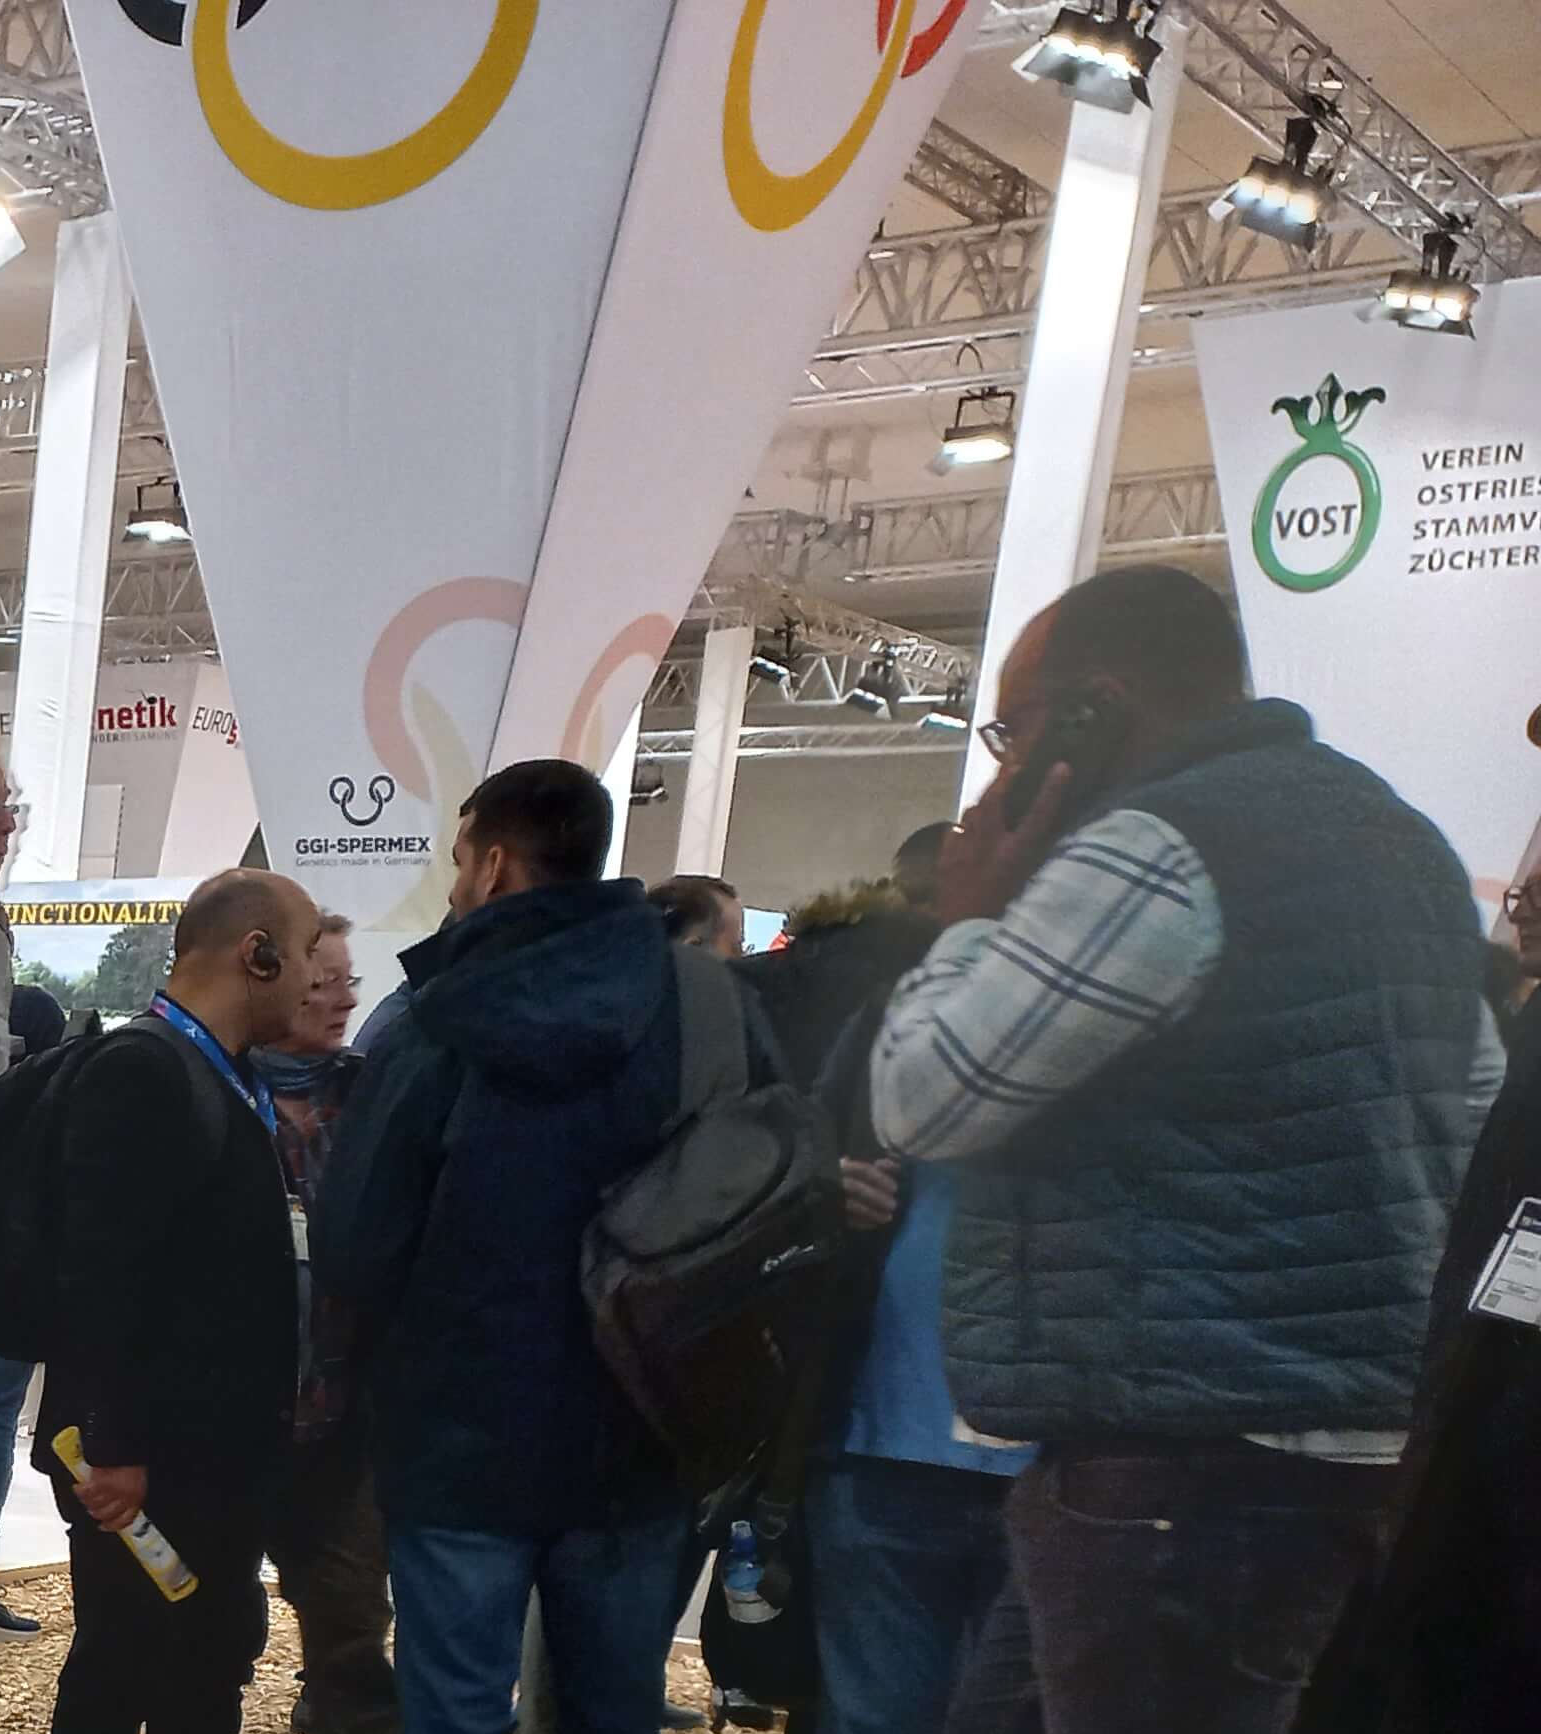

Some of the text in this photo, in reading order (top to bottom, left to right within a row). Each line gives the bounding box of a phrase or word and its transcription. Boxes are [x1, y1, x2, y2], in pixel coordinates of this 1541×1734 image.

[1421, 442, 1523, 471] VEREIN
[1417, 475, 1541, 506] OSTFRIE
[1276, 503, 1358, 540] VOST
[1412, 511, 1541, 541] STAMMV
[295, 836, 431, 855] GGI-SPERMEX
[5, 901, 188, 926] UNCTIONALITY
